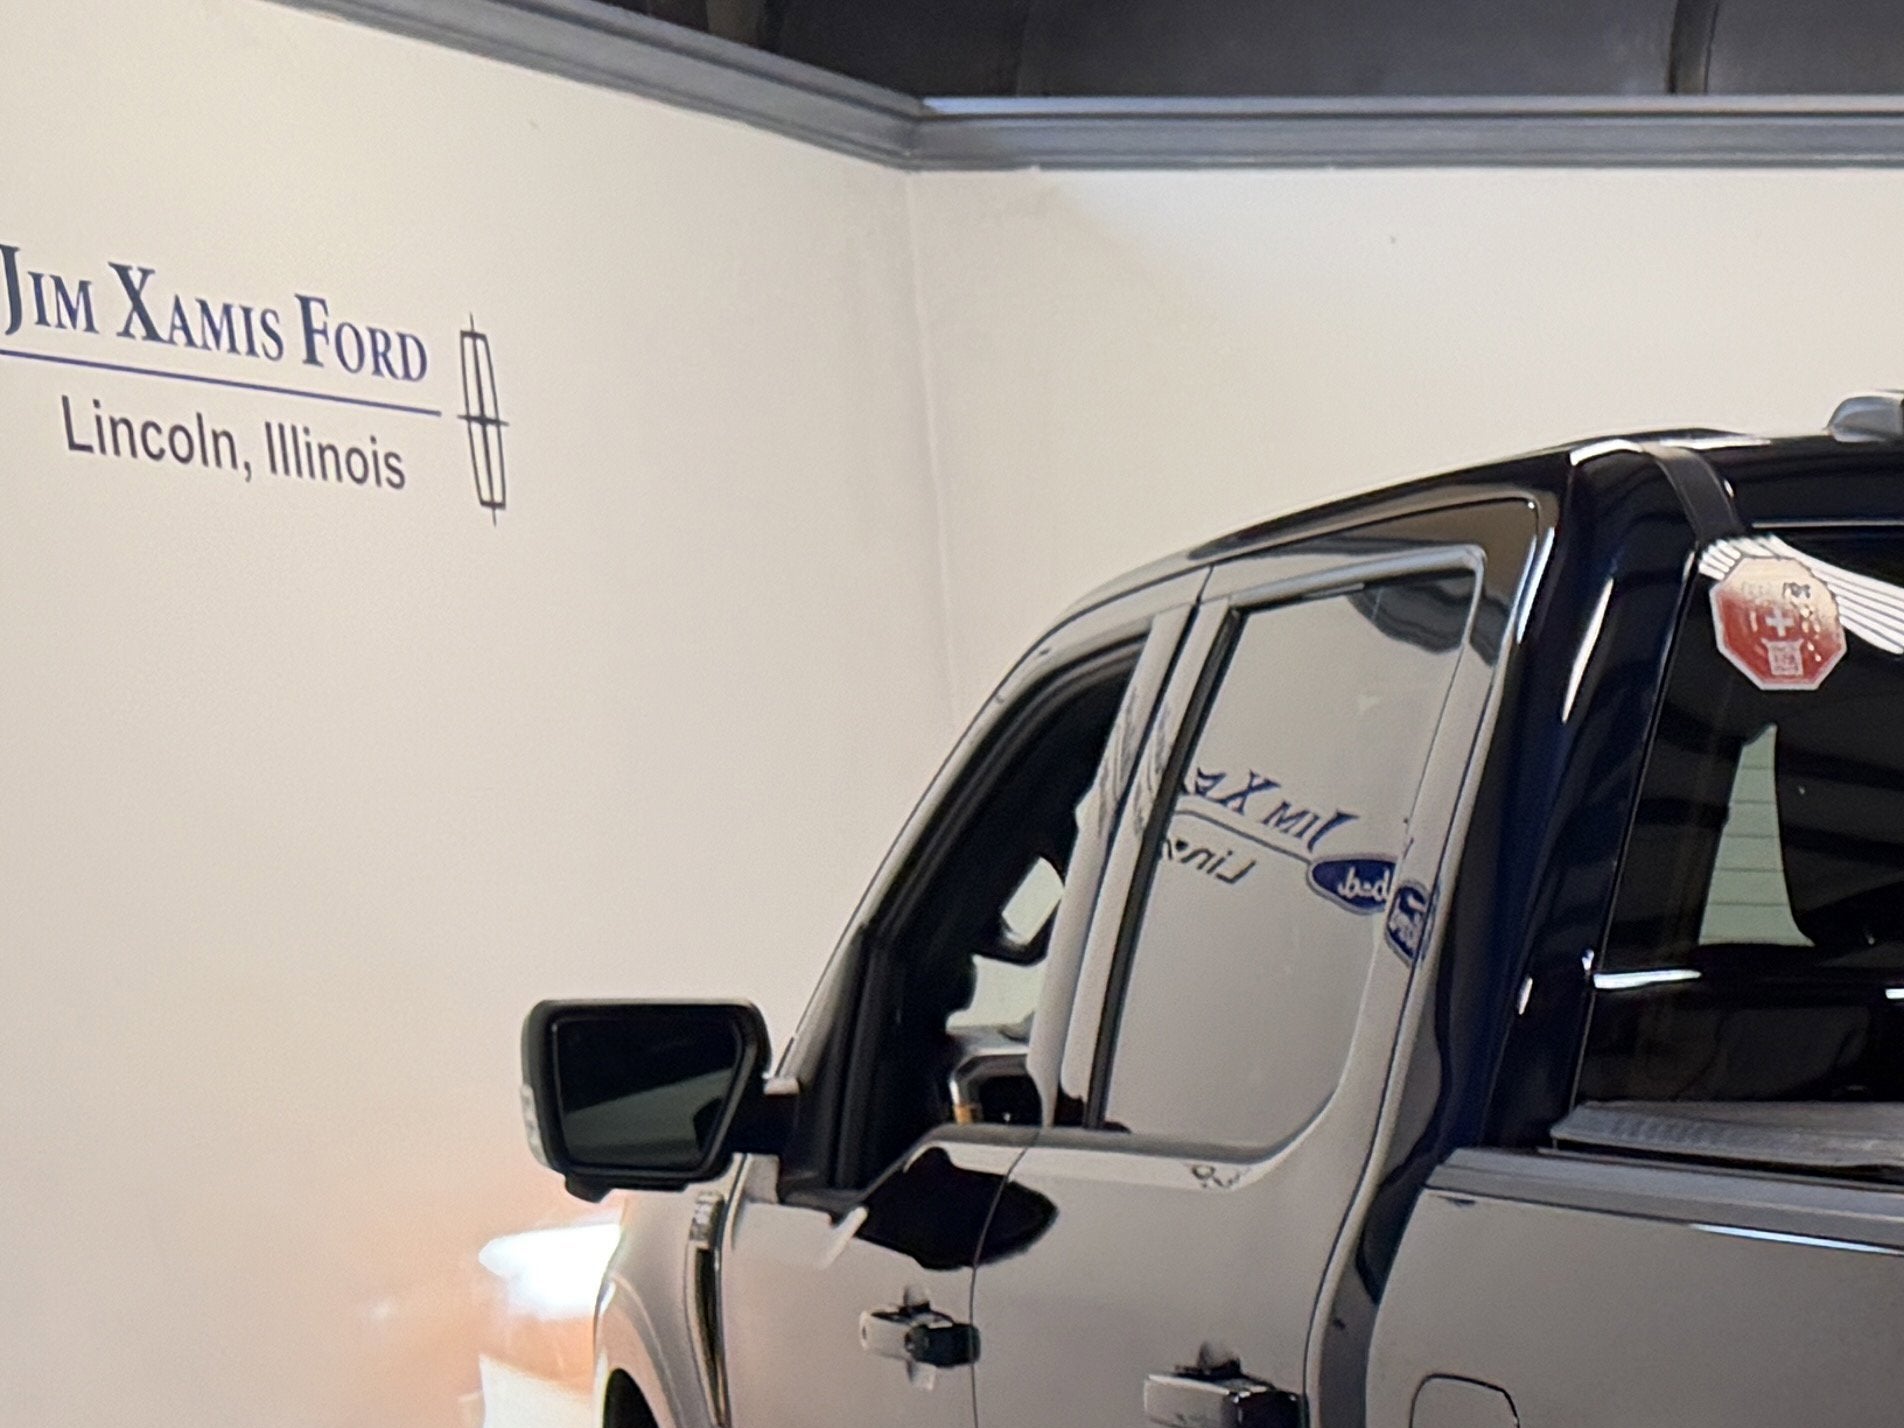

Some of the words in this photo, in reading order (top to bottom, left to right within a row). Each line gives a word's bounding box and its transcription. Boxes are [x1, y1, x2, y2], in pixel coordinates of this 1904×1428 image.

[0, 243, 100, 336] JIM
[107, 261, 284, 361] XAMIS
[294, 293, 428, 383] FORD
[62, 394, 253, 482] Lincoln,
[265, 421, 405, 490] Illinois
